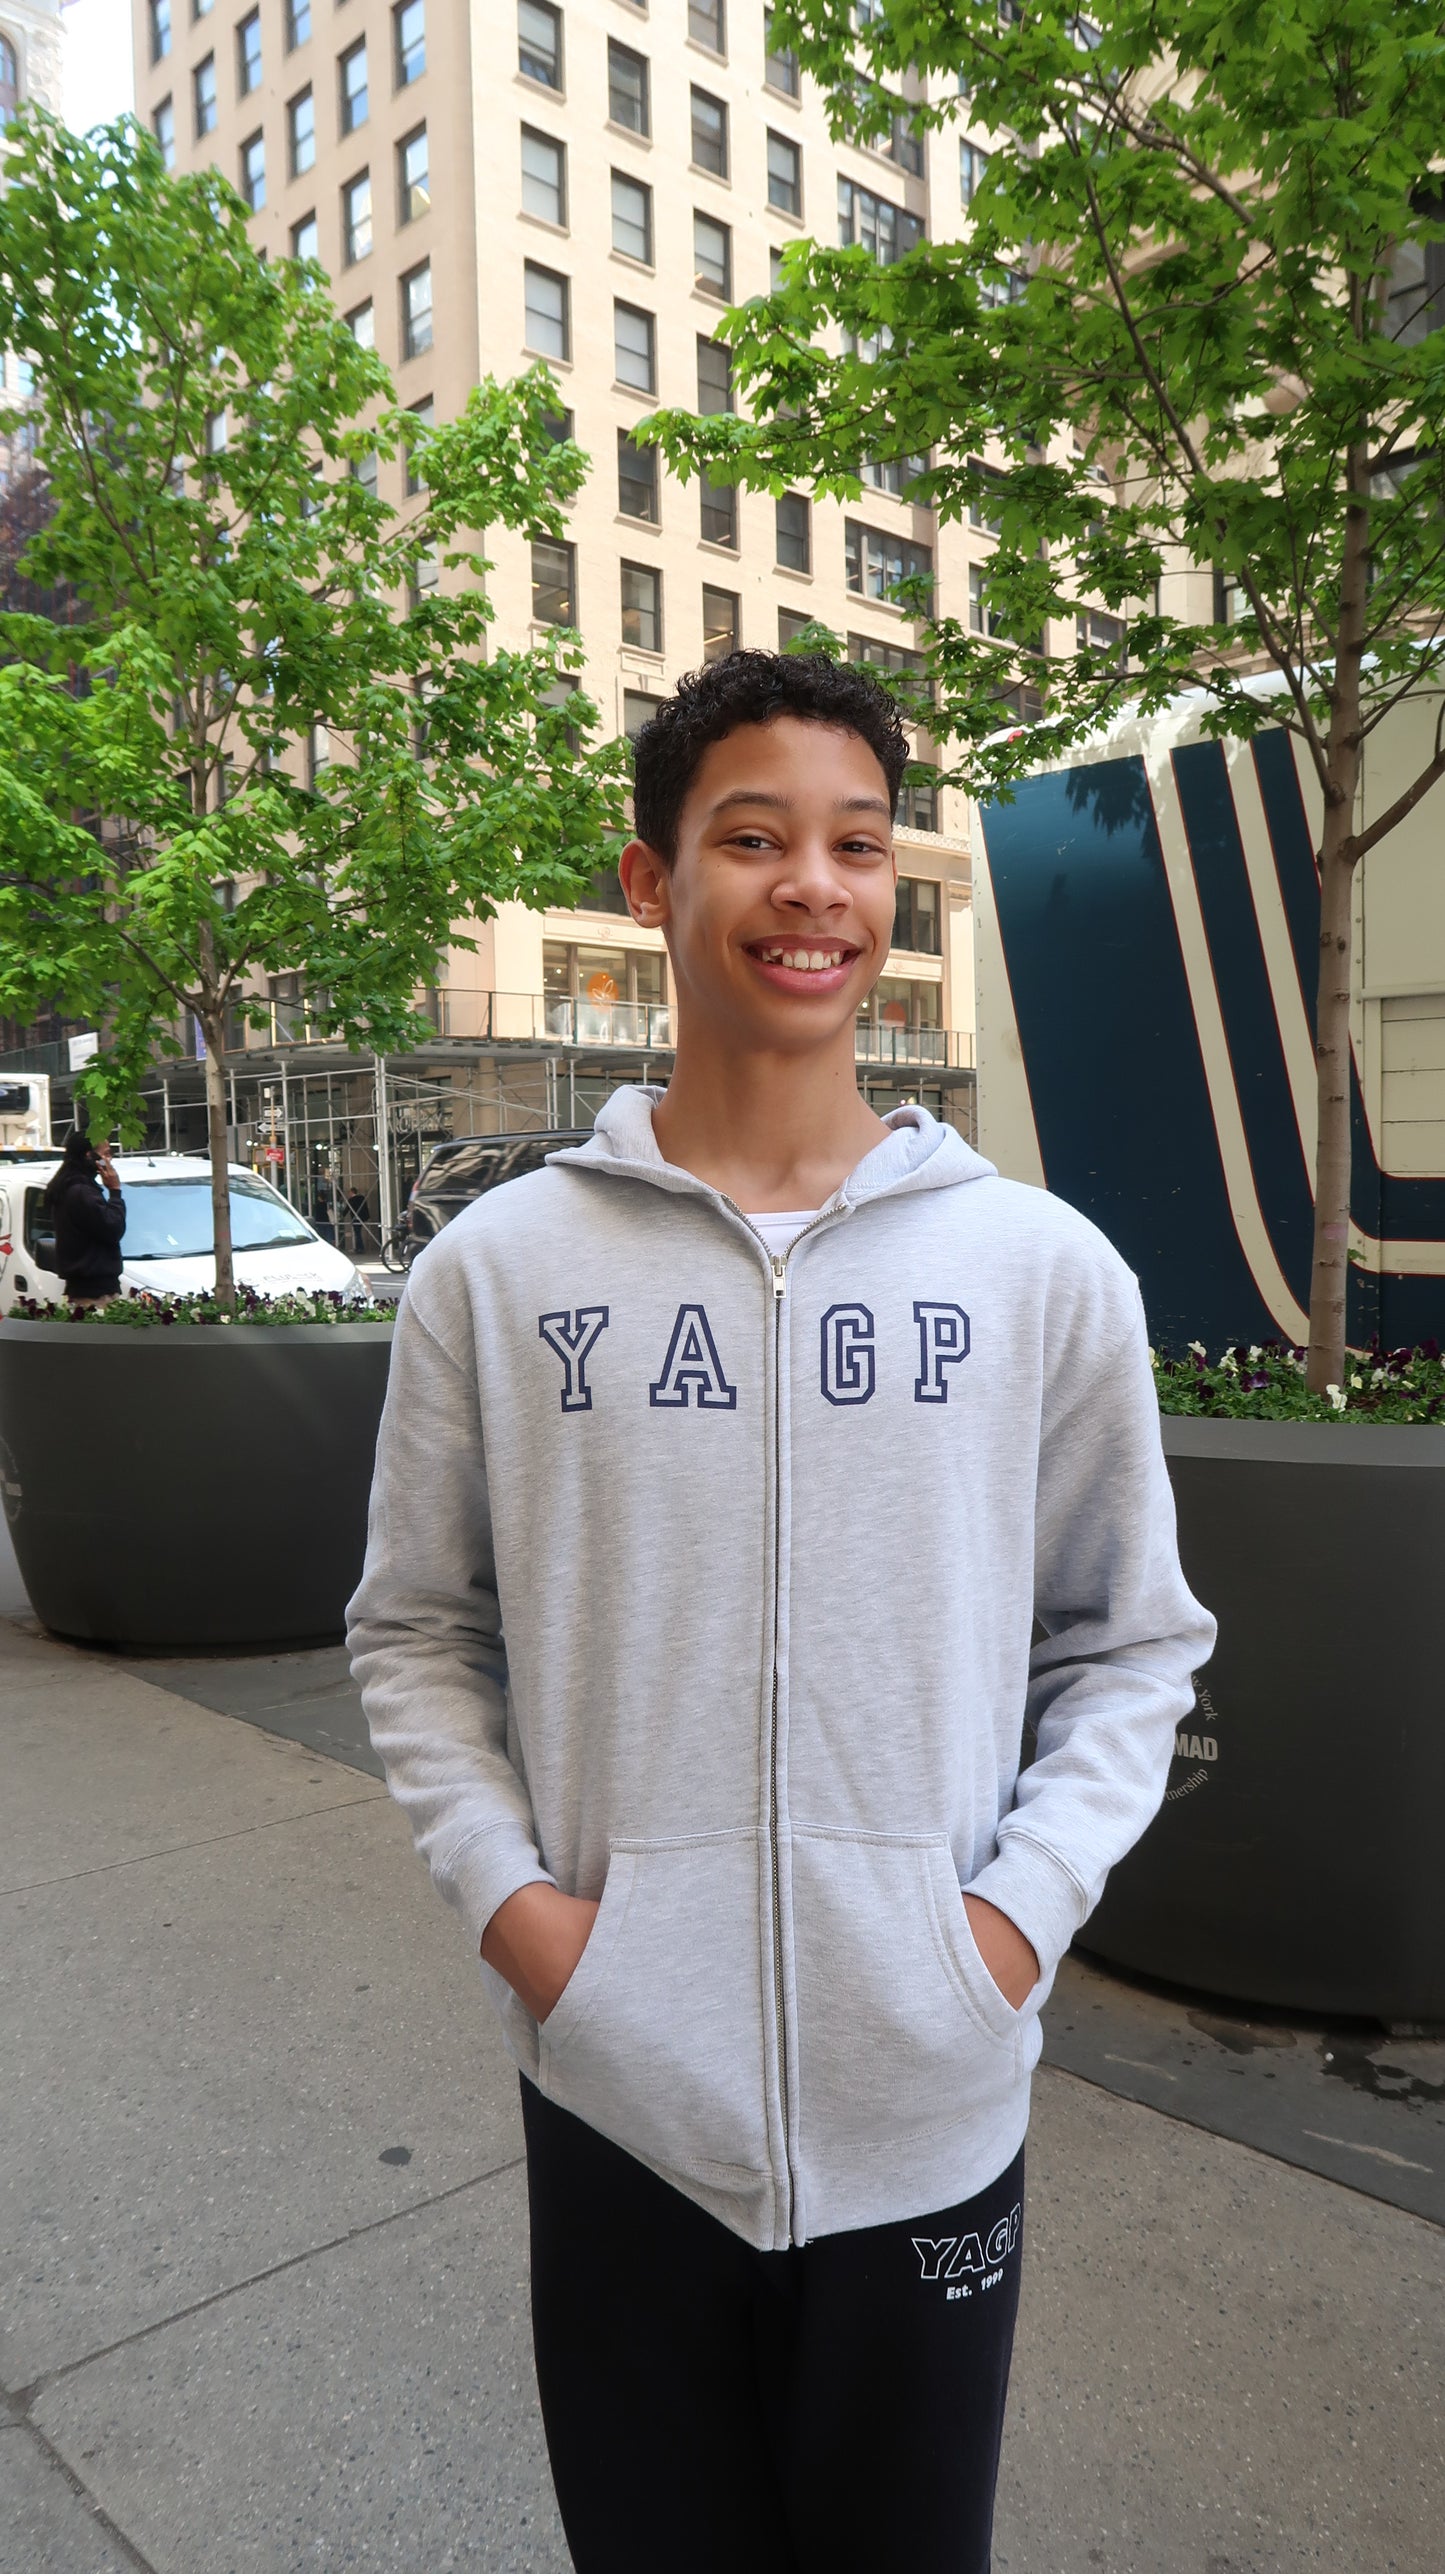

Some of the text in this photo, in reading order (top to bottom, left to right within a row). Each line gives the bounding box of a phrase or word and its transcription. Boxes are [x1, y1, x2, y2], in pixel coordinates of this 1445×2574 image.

[1198, 1688, 1219, 1721] York
[1174, 1733, 1219, 1762] MAD
[1166, 1768, 1209, 1801] tnership
[911, 2202, 1021, 2279] YAGP
[946, 2267, 1004, 2300] Est. 1999
